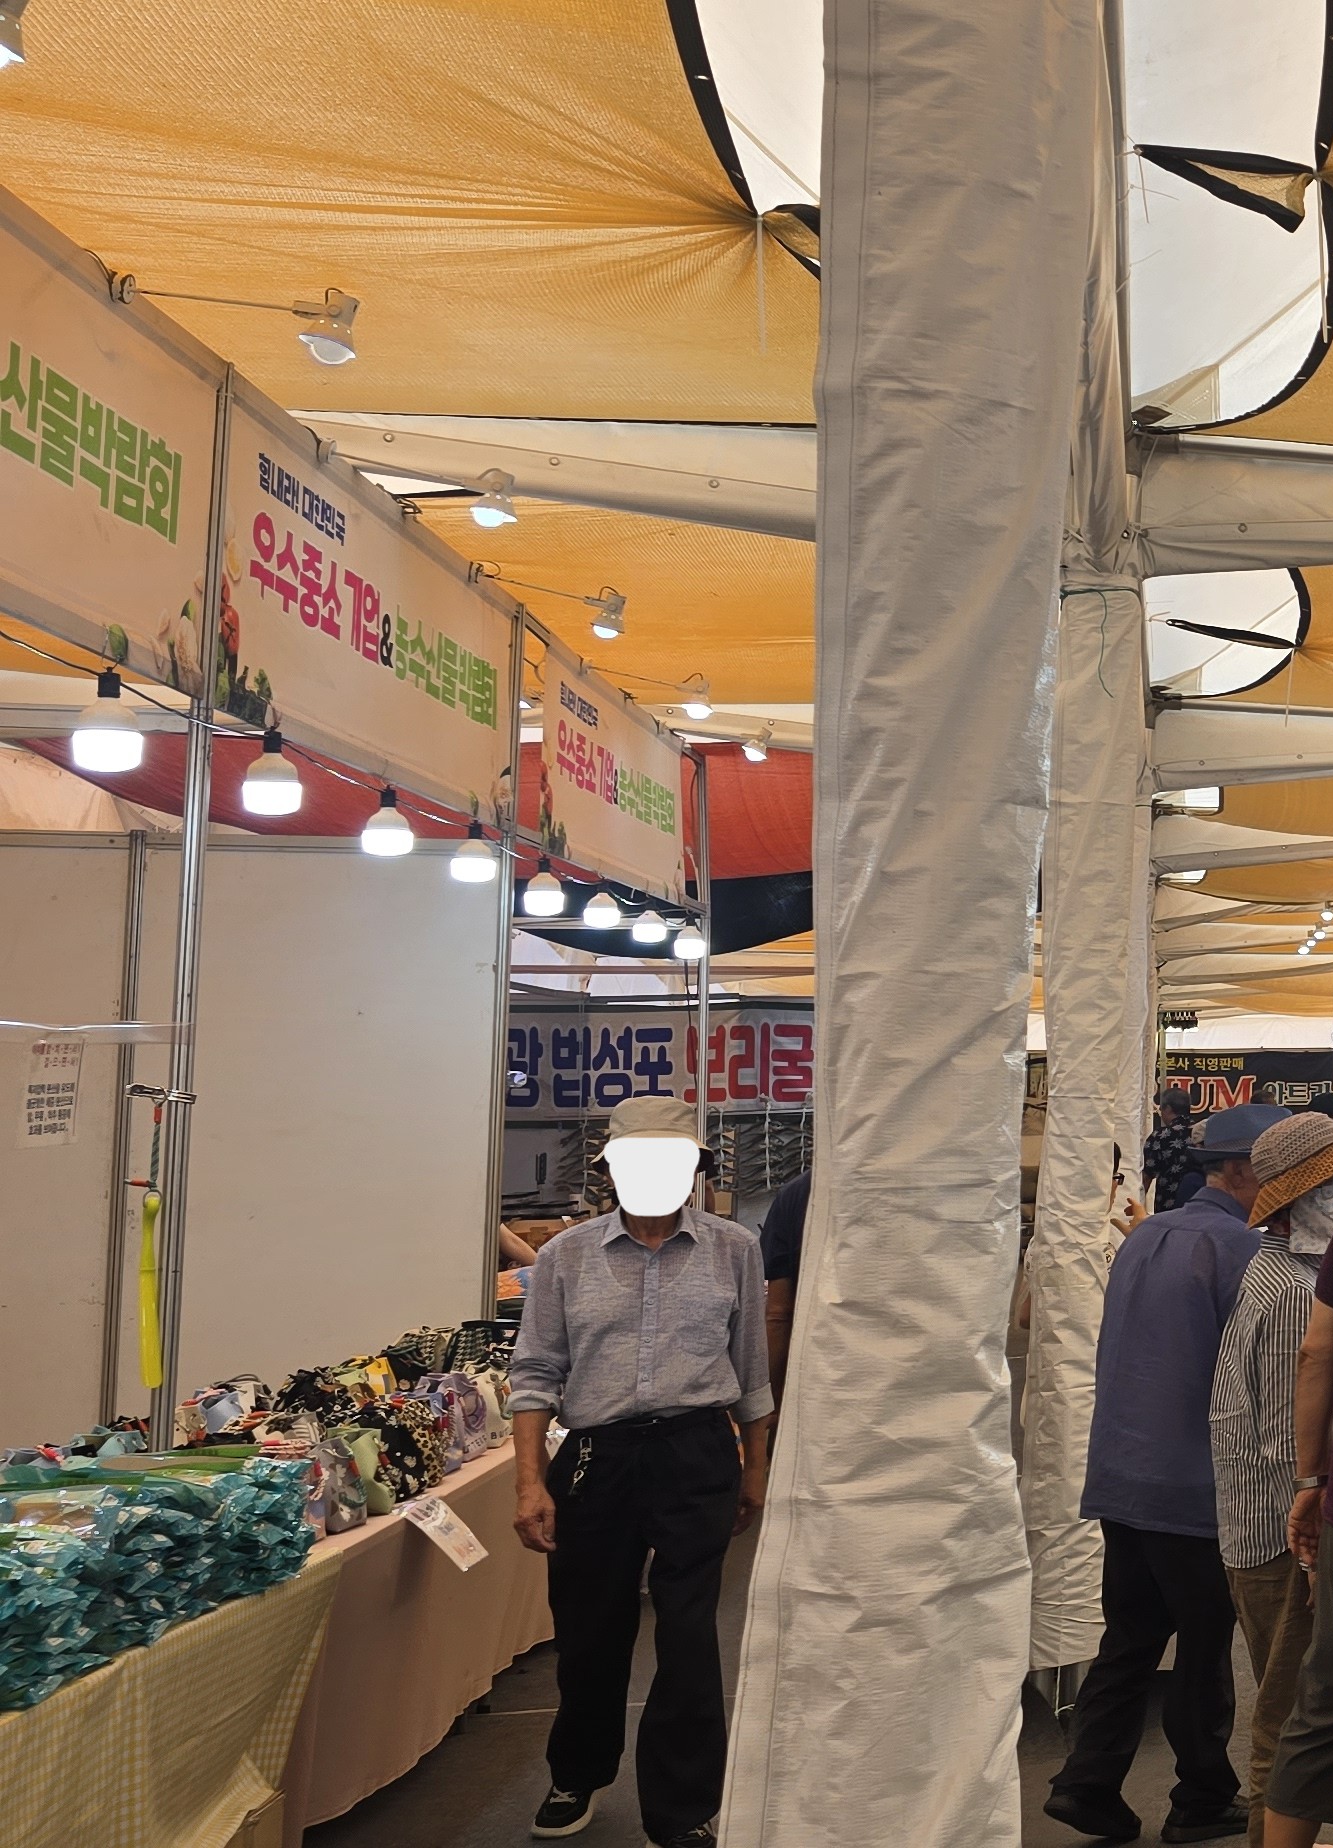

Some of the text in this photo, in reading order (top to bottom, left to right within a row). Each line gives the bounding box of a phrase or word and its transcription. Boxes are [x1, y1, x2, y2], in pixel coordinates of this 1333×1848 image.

[0, 340, 183, 545] 산물박람회
[258, 452, 346, 546] 힘내라! 대한민국
[552, 1025, 673, 1107] 법성포
[1157, 1057, 1244, 1070] 본사 직영판매
